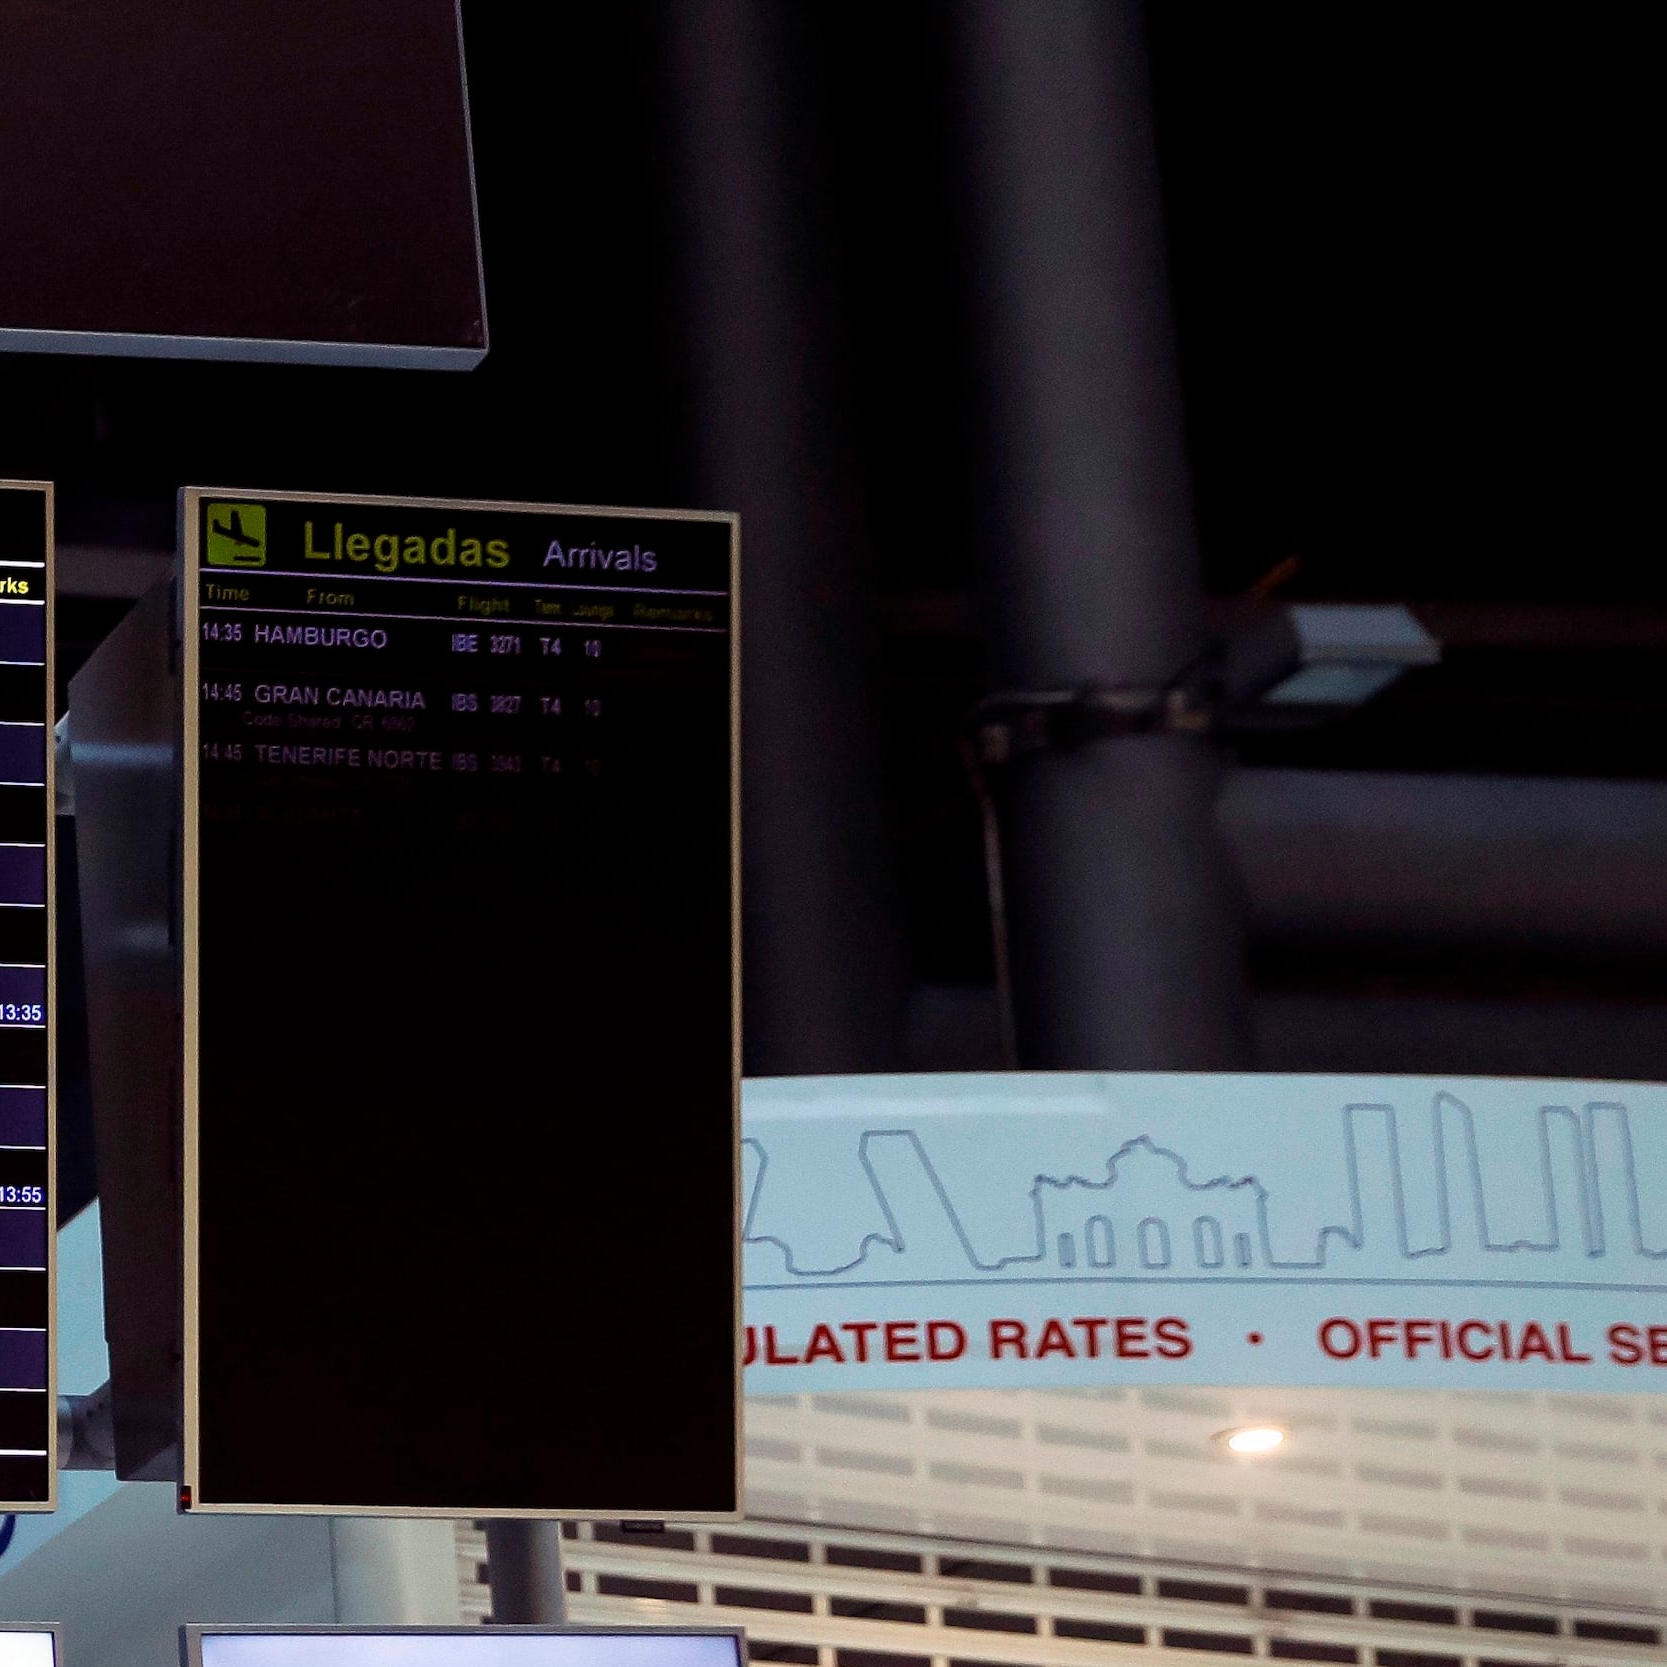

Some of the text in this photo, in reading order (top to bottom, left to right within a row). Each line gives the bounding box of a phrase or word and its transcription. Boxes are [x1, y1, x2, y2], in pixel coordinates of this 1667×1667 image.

[305, 521, 657, 572] Llegadas Arrivals
[203, 622, 387, 649] 14:35 HAMBURGO
[203, 683, 425, 709] 14:45 GRAN CANARIA
[990, 1318, 1192, 1360] RATES
[1319, 1318, 1593, 1364] OFFICIAL
[1608, 1325, 1667, 1366] SE
